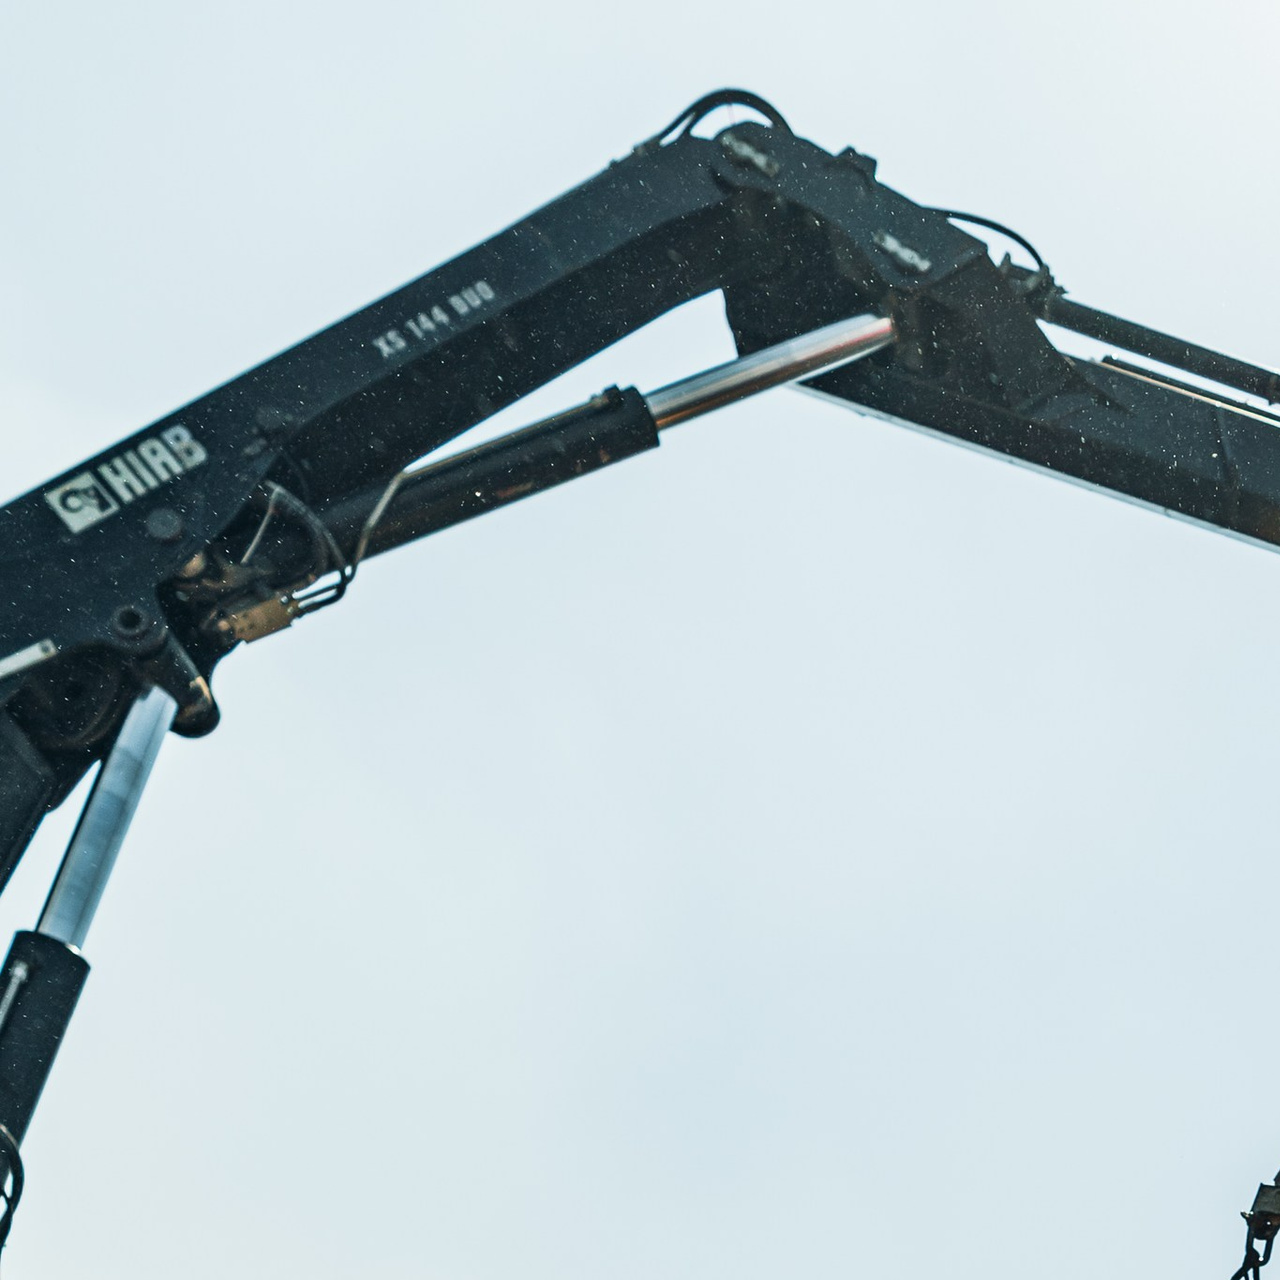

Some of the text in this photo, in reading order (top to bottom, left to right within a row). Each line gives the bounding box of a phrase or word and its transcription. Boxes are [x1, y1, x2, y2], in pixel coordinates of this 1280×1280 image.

[372, 329, 406, 358] XS
[405, 305, 450, 339] 144
[97, 423, 207, 504] HIAB
